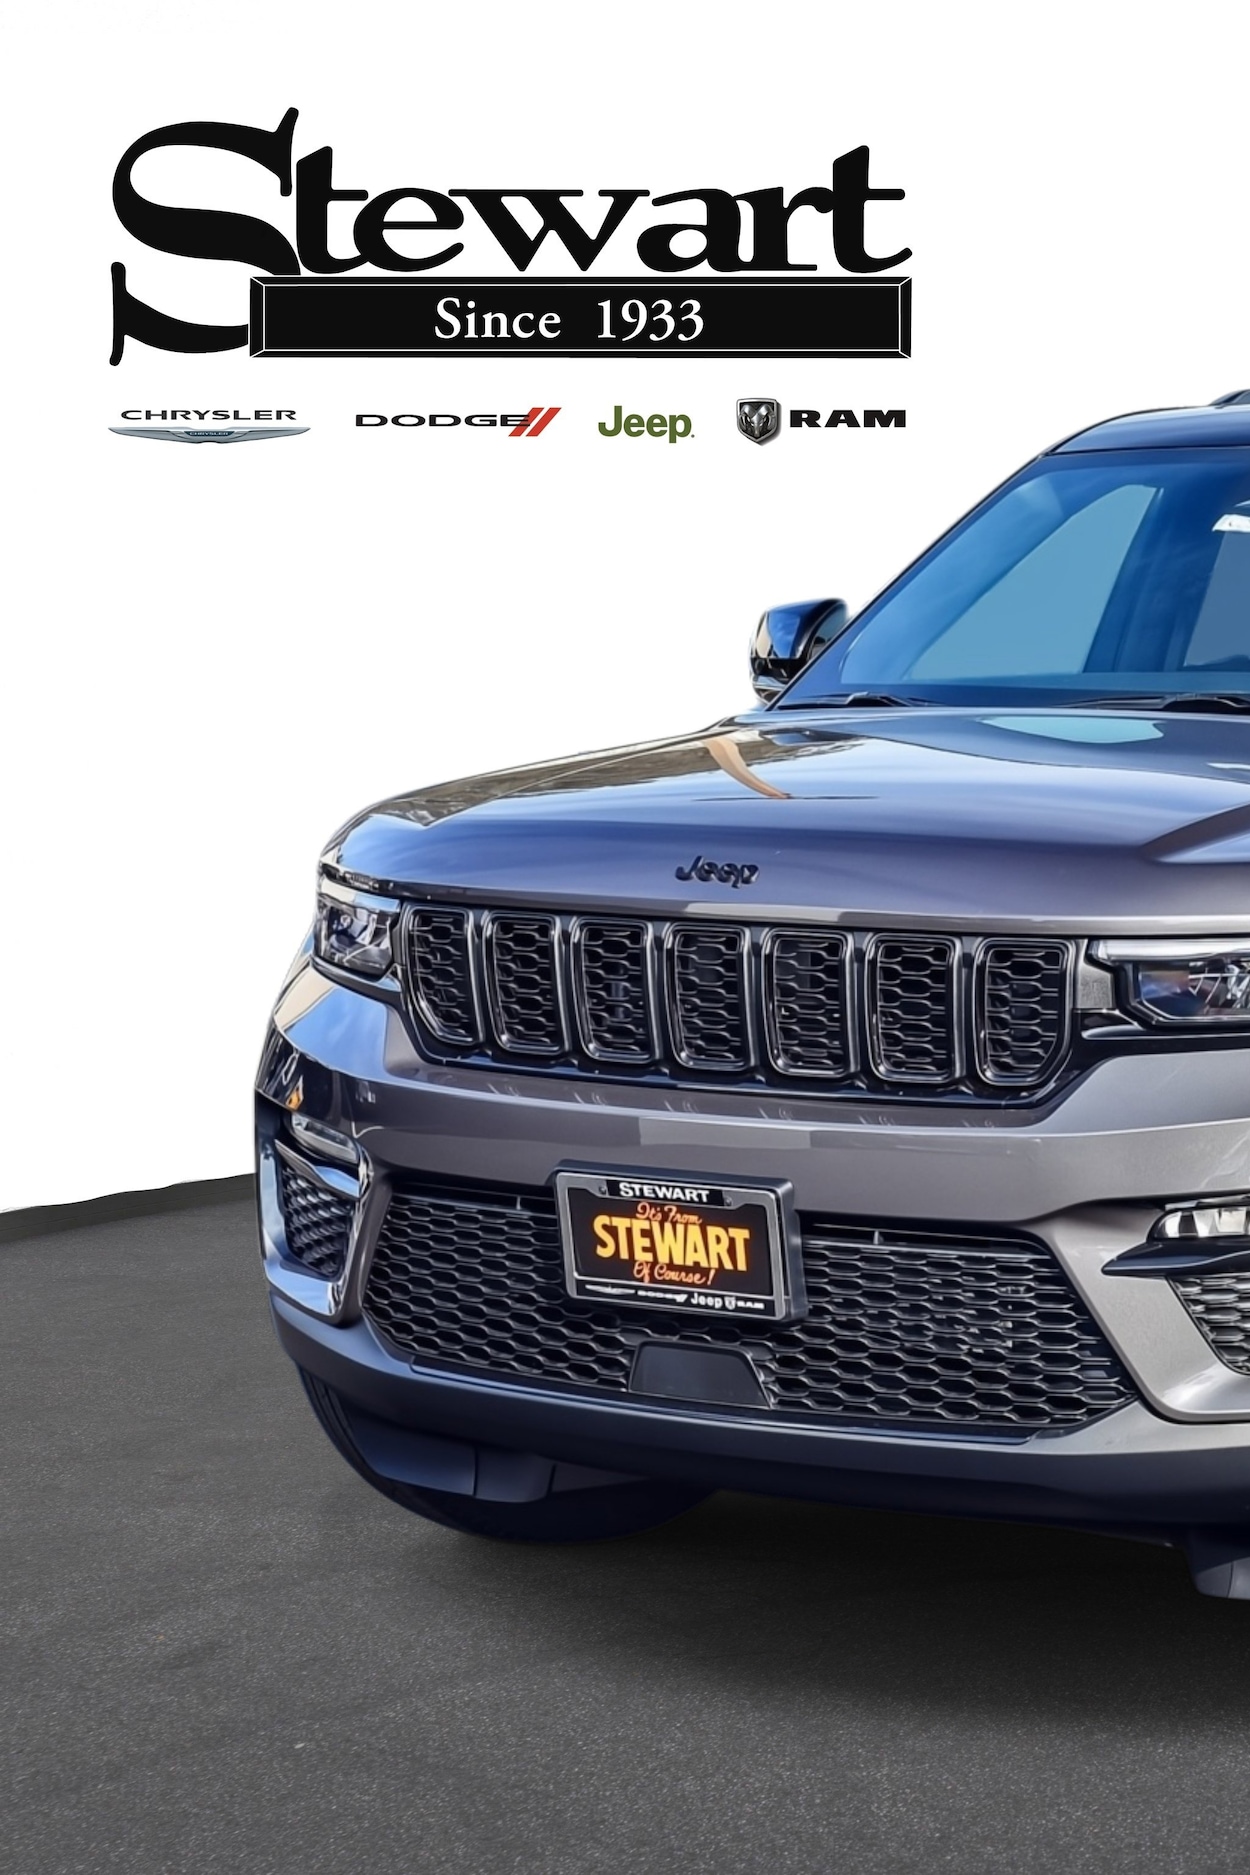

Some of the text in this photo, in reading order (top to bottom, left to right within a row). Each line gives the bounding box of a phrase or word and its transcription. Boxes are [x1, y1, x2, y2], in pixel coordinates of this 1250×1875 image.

[675, 855, 759, 889] Jeep
[619, 1182, 710, 1203] STEWART
[663, 1205, 703, 1225] From
[593, 1214, 751, 1272] STEWART
[690, 1292, 723, 1309] Jeep
